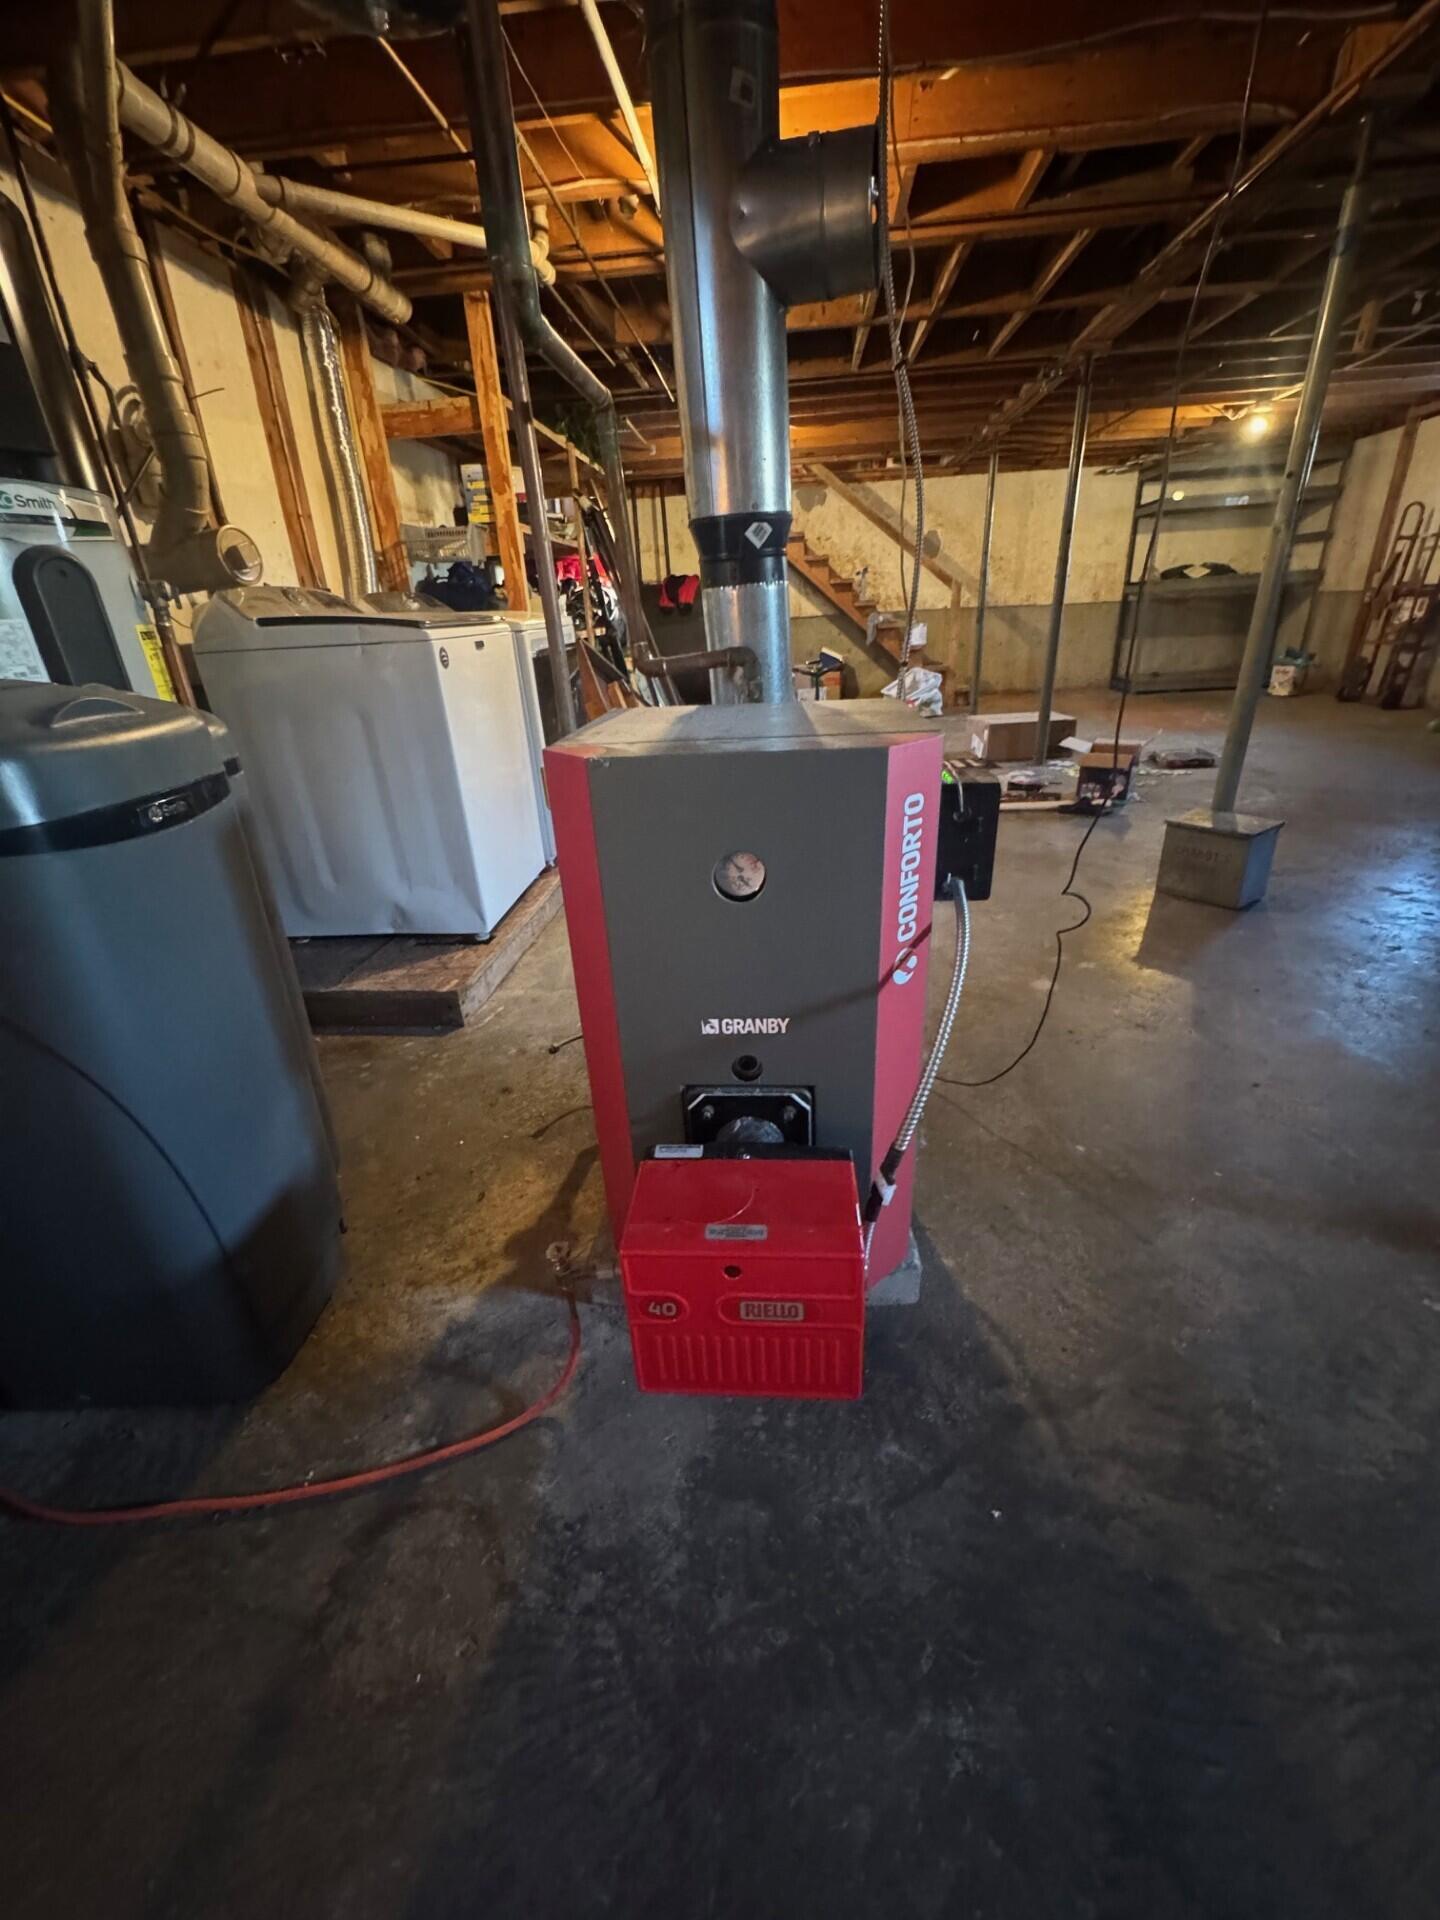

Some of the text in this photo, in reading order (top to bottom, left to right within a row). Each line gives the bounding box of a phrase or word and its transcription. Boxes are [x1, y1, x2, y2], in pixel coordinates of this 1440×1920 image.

[14, 494, 56, 510] Smith
[897, 792, 925, 943] CONFORTO
[721, 1018, 790, 1034] GRANBY
[648, 1302, 677, 1316] 40
[744, 1303, 799, 1318] RIELLO
